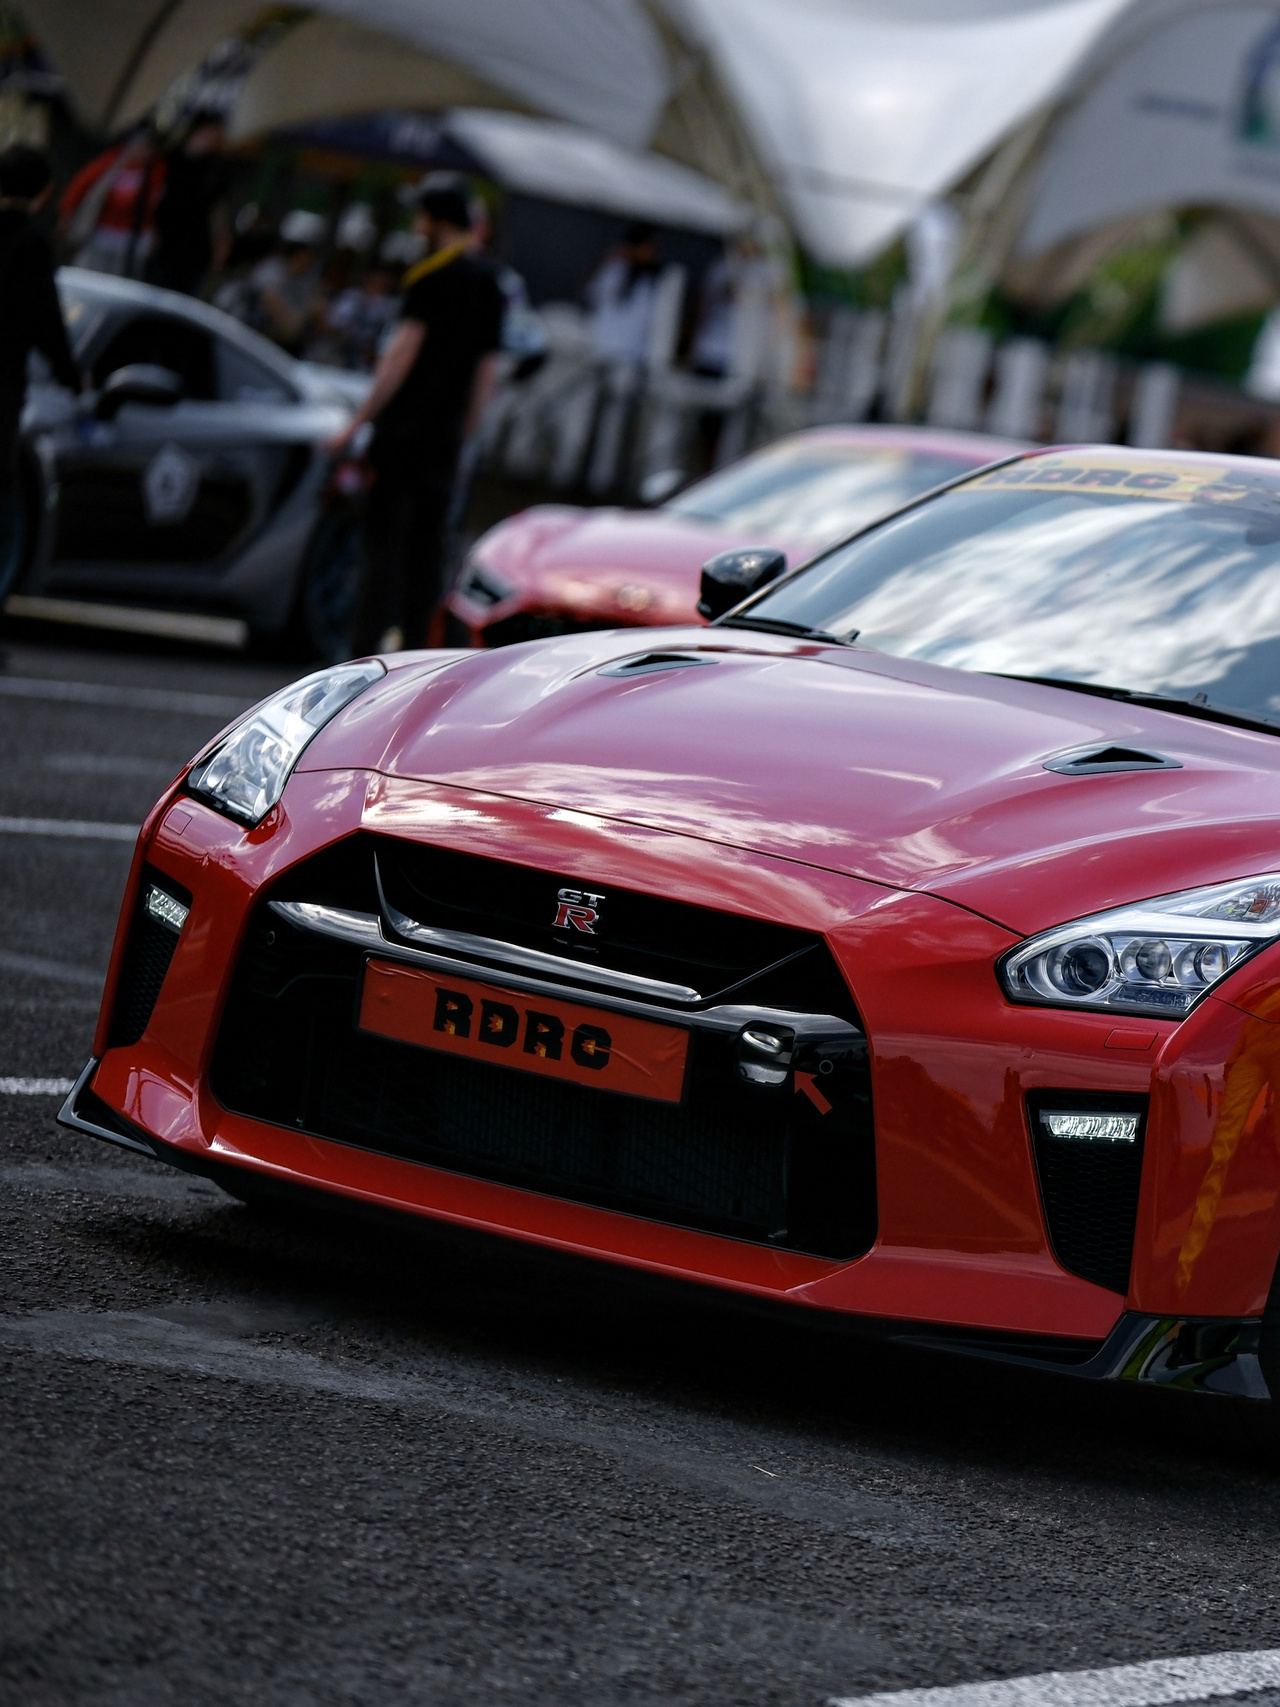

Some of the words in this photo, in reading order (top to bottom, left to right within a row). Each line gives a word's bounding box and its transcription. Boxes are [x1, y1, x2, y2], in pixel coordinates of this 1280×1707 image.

[557, 888, 606, 907] GT
[551, 902, 599, 935] R
[433, 986, 613, 1071] RDRC
